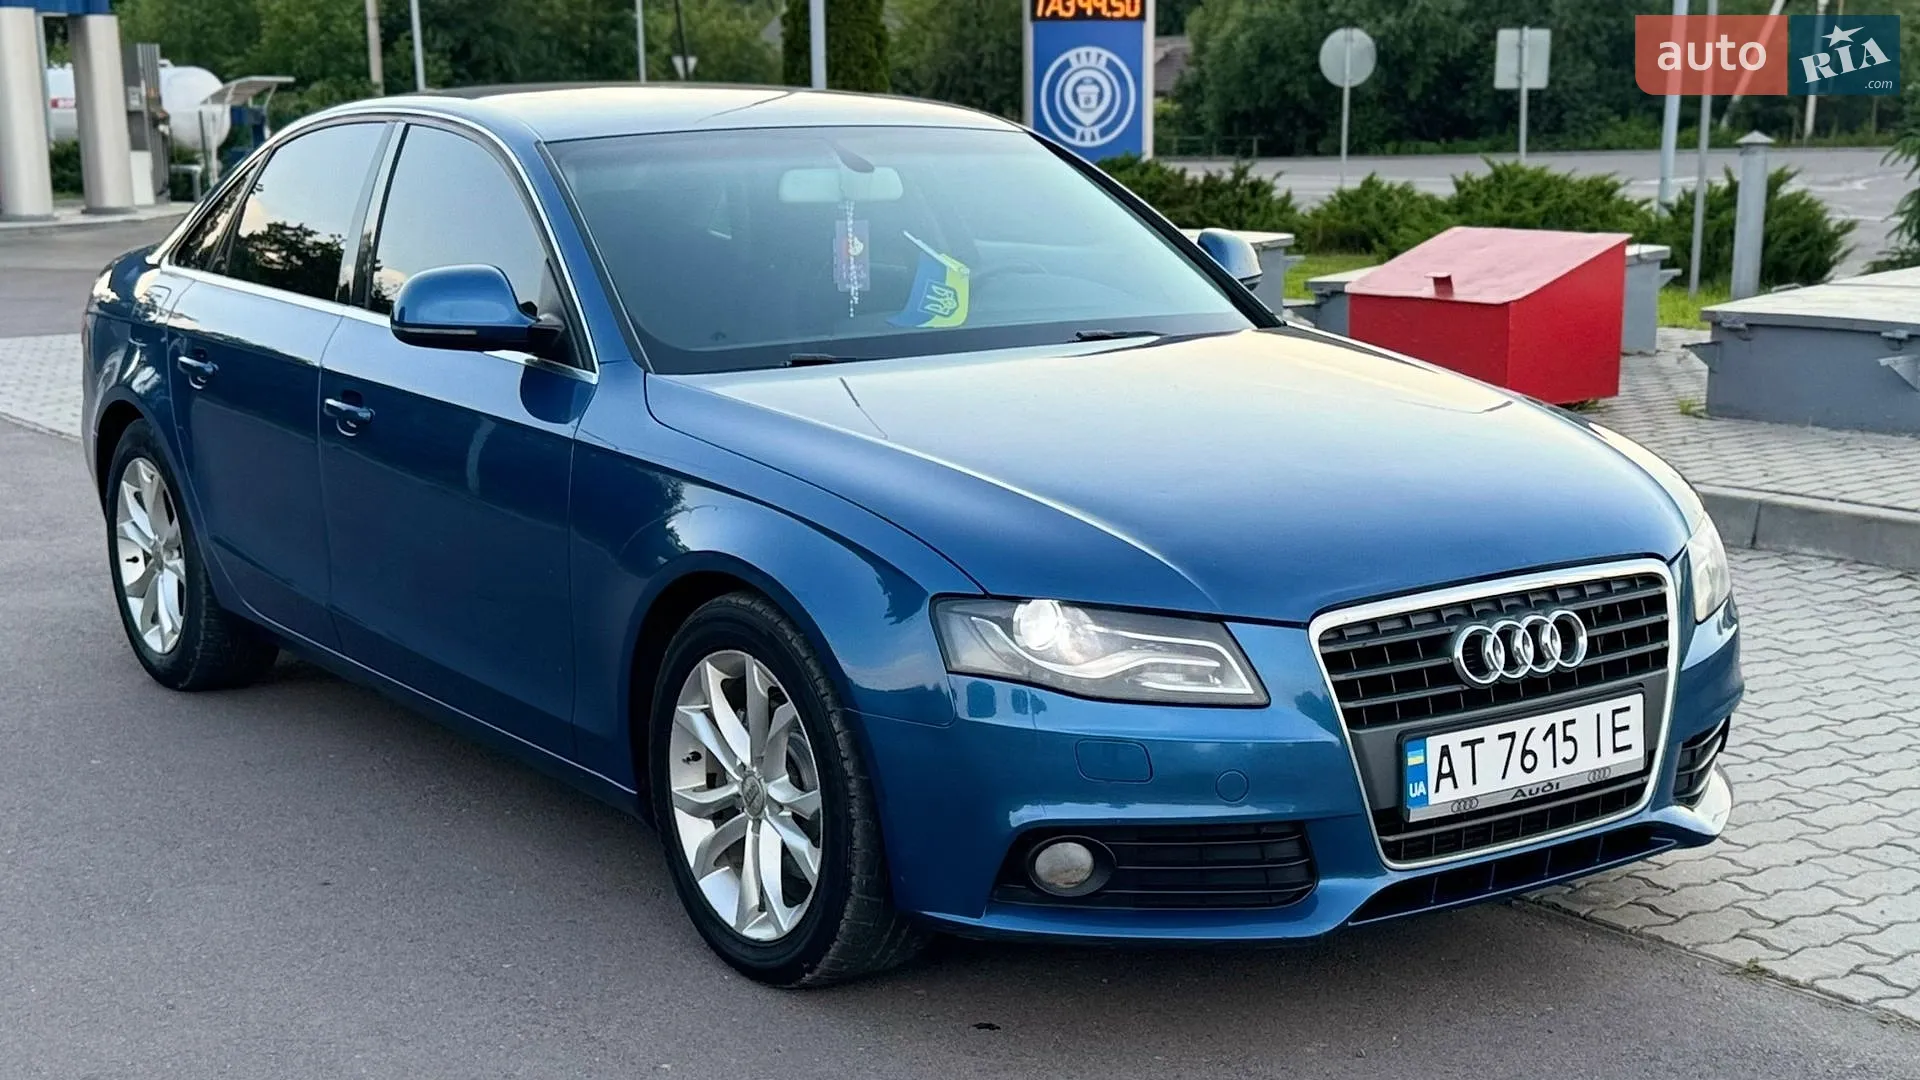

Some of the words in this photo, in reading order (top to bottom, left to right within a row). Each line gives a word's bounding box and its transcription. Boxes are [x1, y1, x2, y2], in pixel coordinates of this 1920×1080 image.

[1434, 737, 1485, 793] AT
[1498, 718, 1578, 780] 7615
[1596, 705, 1633, 758] IE
[1409, 781, 1426, 798] UA
[1510, 782, 1560, 800] Audi
